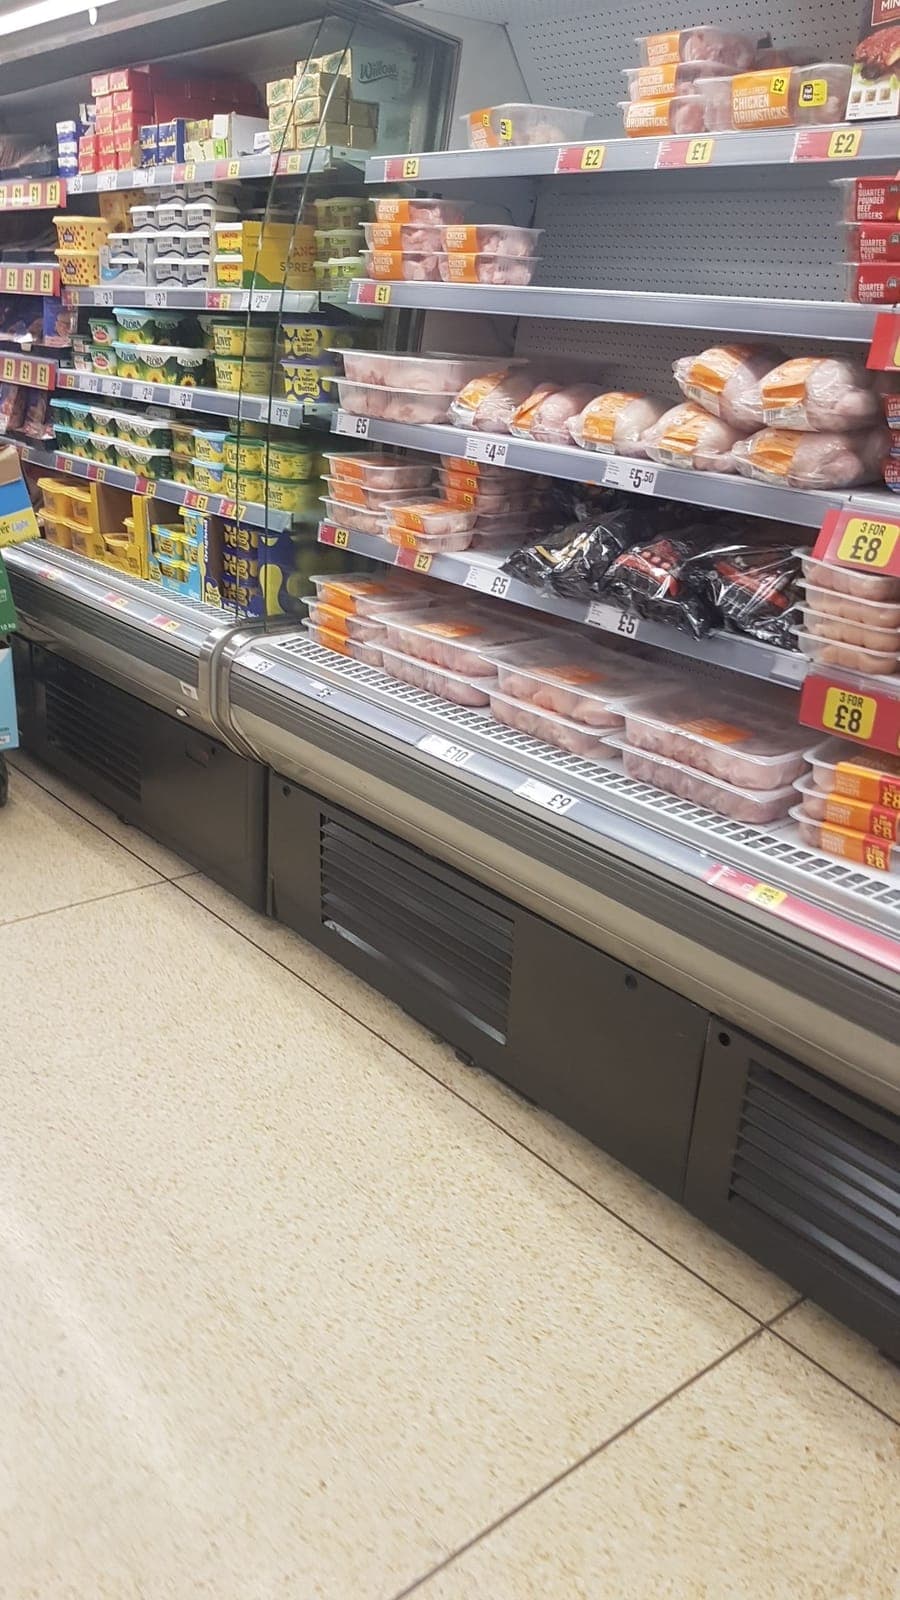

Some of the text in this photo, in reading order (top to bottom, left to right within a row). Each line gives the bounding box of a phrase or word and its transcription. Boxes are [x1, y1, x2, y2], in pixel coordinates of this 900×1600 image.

[360, 61, 399, 76] Willow
[773, 78, 785, 92] £2
[733, 94, 769, 111] CHICKEN
[733, 106, 787, 124] DRUMSTICKS
[834, 132, 856, 153] £2
[585, 149, 604, 166] £2
[691, 143, 708, 161] £1
[230, 163, 238, 175] £2
[405, 160, 417, 175] £2
[32, 187, 39, 201] £1
[50, 183, 57, 198] £1
[858, 188, 885, 197] QUARTER
[858, 196, 884, 204] POUNDER
[857, 204, 872, 212] BEEF
[857, 211, 883, 220] BURGERS
[860, 239, 886, 247] QUARTER
[860, 246, 886, 254] POUNDER
[26, 272, 33, 286] £1
[43, 273, 50, 288] £1
[377, 286, 388, 298] £1
[859, 283, 884, 291] QUARTER
[859, 291, 884, 299] POUNDER
[122, 318, 141, 329] FLORA
[5, 360, 13, 376] £1
[146, 354, 164, 369] FLORA
[181, 358, 201, 368] FLORA
[22, 362, 30, 379] £1
[39, 364, 47, 383] £1
[355, 418, 368, 434] £5
[628, 467, 654, 488] £5.50
[860, 522, 886, 537] 3 FOR
[337, 531, 347, 545] £3
[850, 535, 882, 563] £8
[416, 555, 430, 569] £2
[491, 576, 509, 594] £5
[618, 614, 635, 634] £5
[840, 692, 864, 708] 3 FOR
[834, 705, 862, 733] £8
[442, 745, 469, 763] £10
[550, 794, 572, 810] £9
